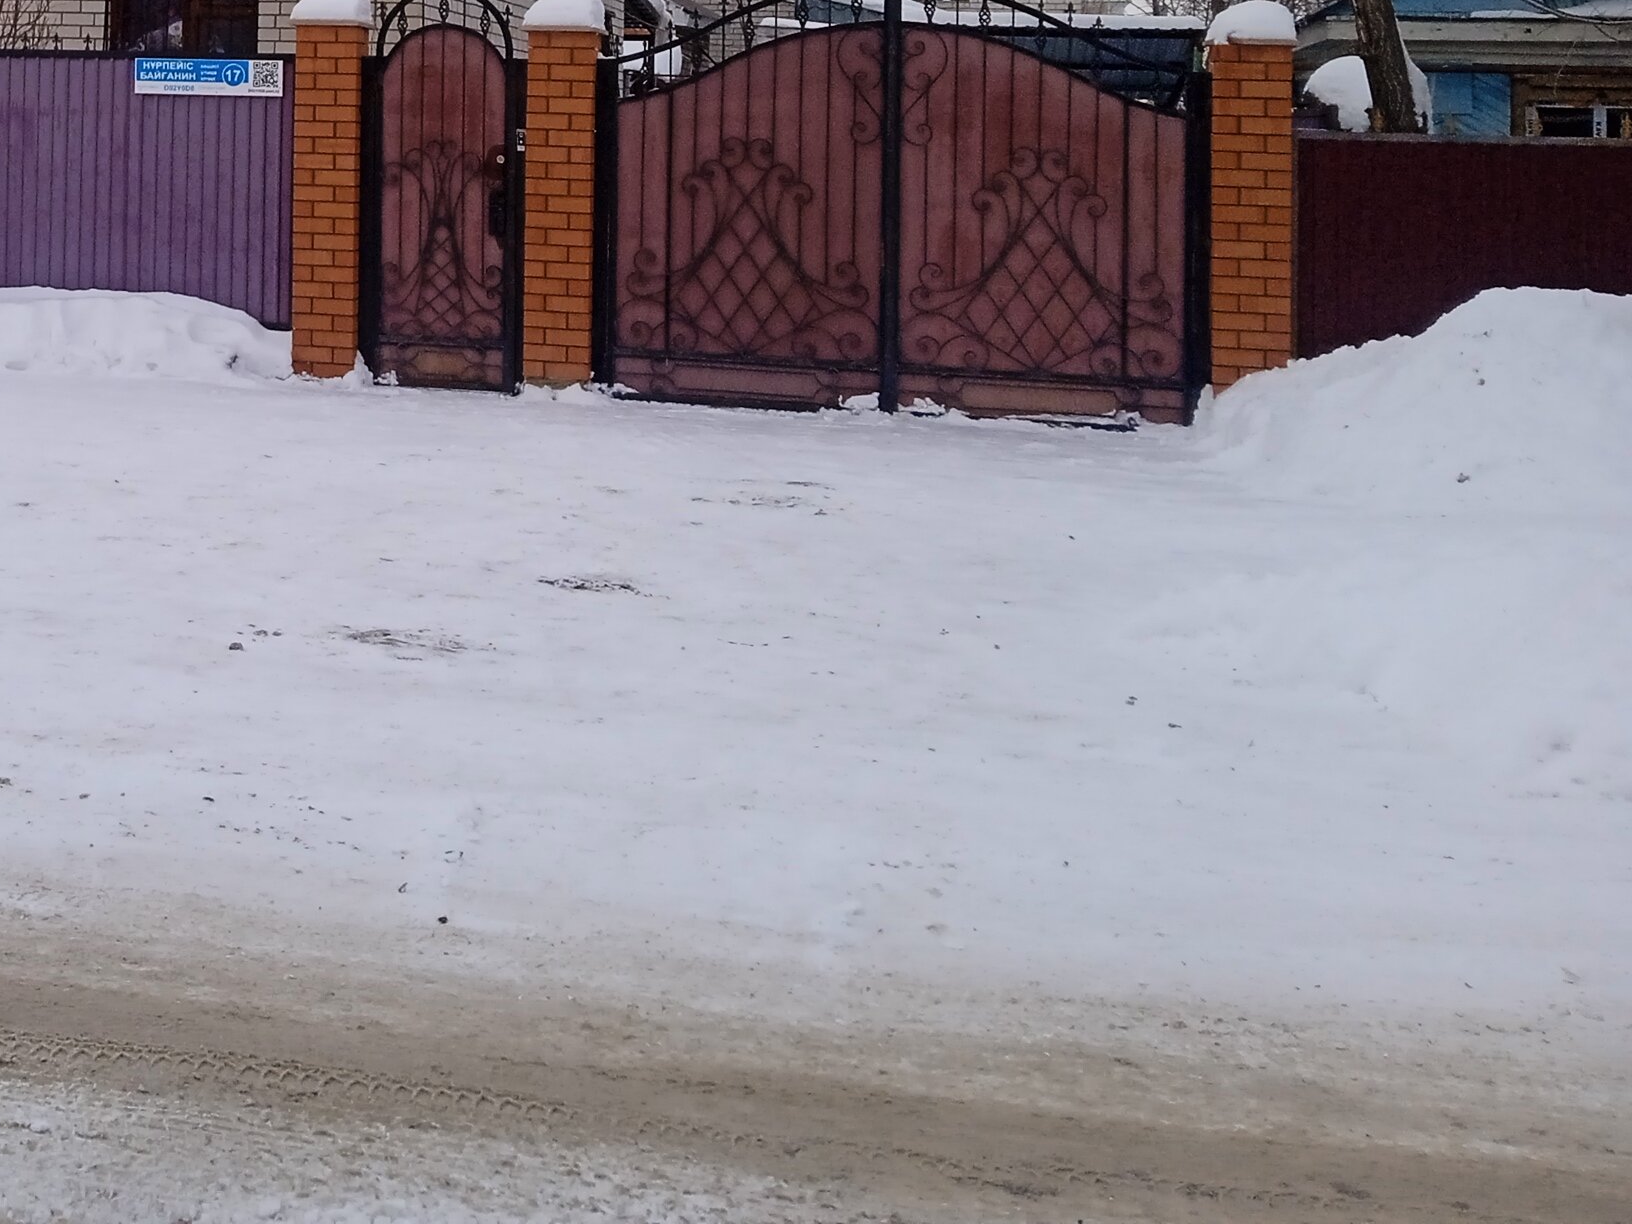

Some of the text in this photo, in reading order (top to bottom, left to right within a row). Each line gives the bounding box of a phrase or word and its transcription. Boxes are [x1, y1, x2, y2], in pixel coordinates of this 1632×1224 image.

[143, 60, 194, 70] НҰРПЕЙІС
[140, 71, 196, 80] БАЙГАНИН
[225, 70, 241, 81] 17
